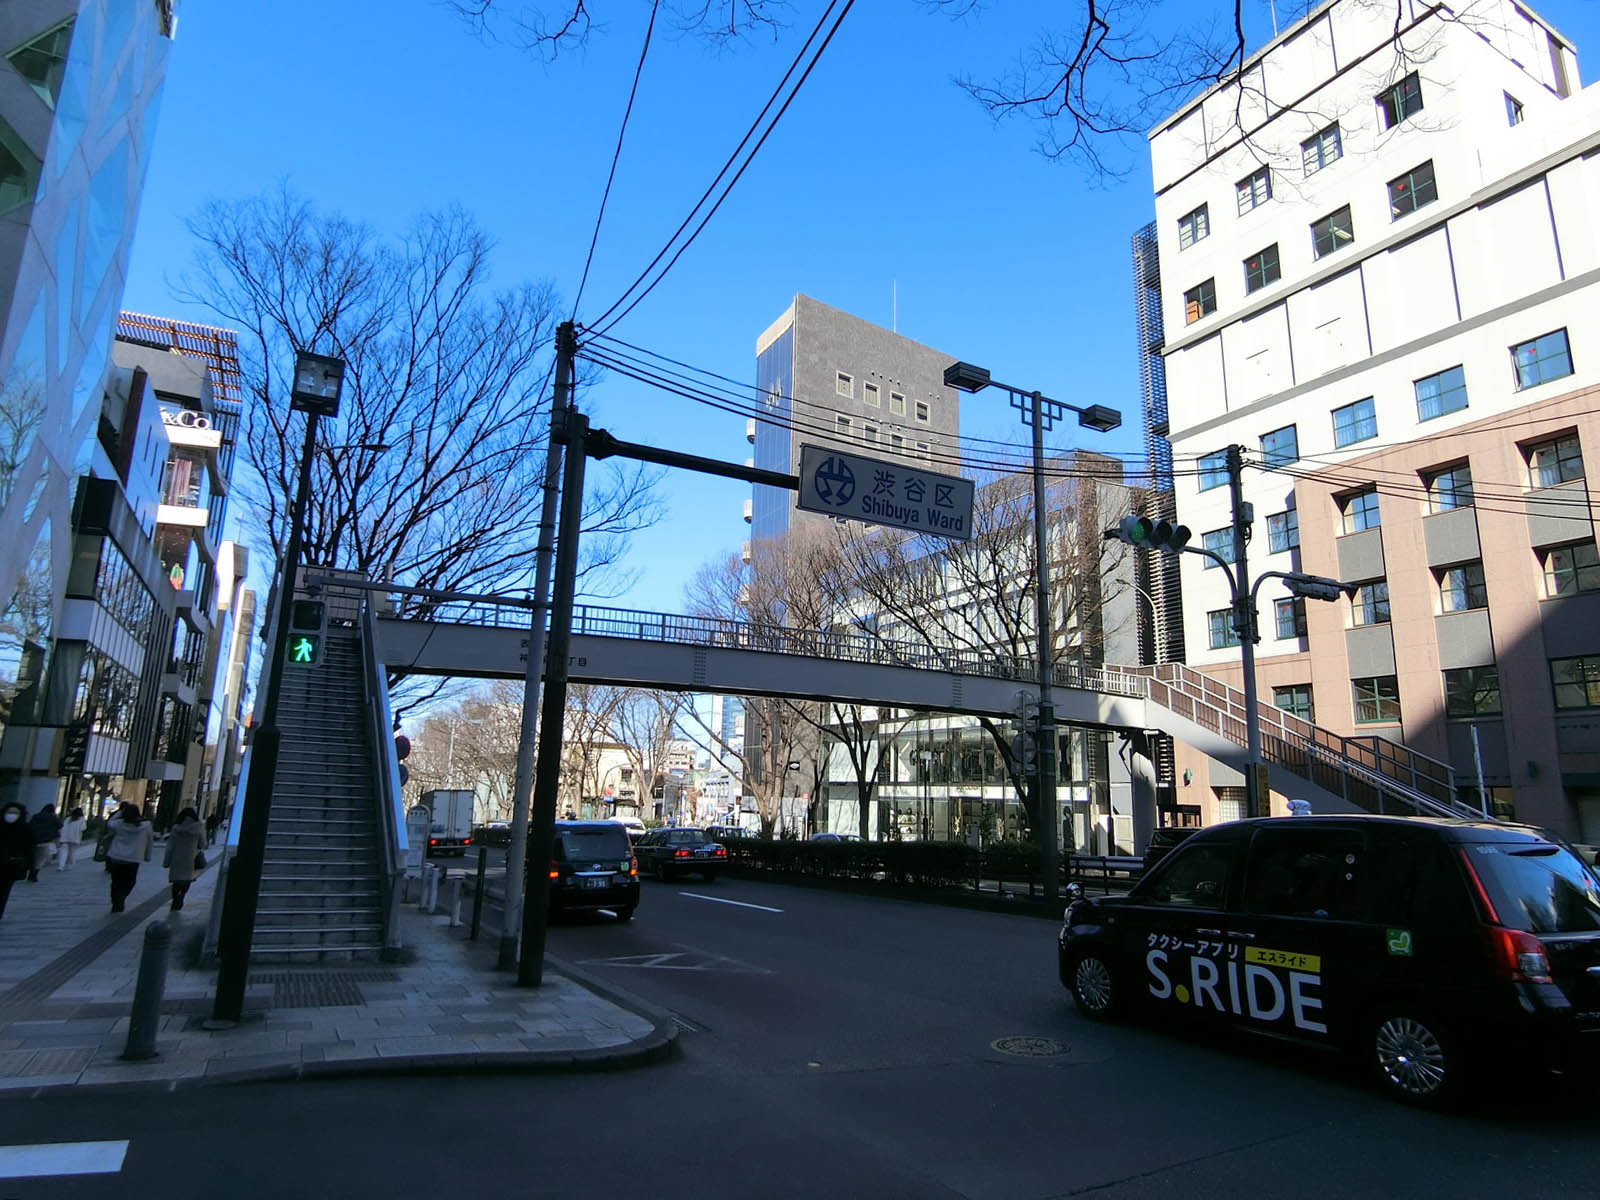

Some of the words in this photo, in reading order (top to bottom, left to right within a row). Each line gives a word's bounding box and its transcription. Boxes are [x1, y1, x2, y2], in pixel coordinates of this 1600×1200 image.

[872, 469, 956, 508] 渋谷区
[862, 494, 919, 524] Shibuya
[927, 508, 963, 532] Ward
[1147, 932, 1239, 960] タクシーアプリ
[1257, 950, 1307, 967] エスライド
[1146, 949, 1328, 1034] S.RIDE
